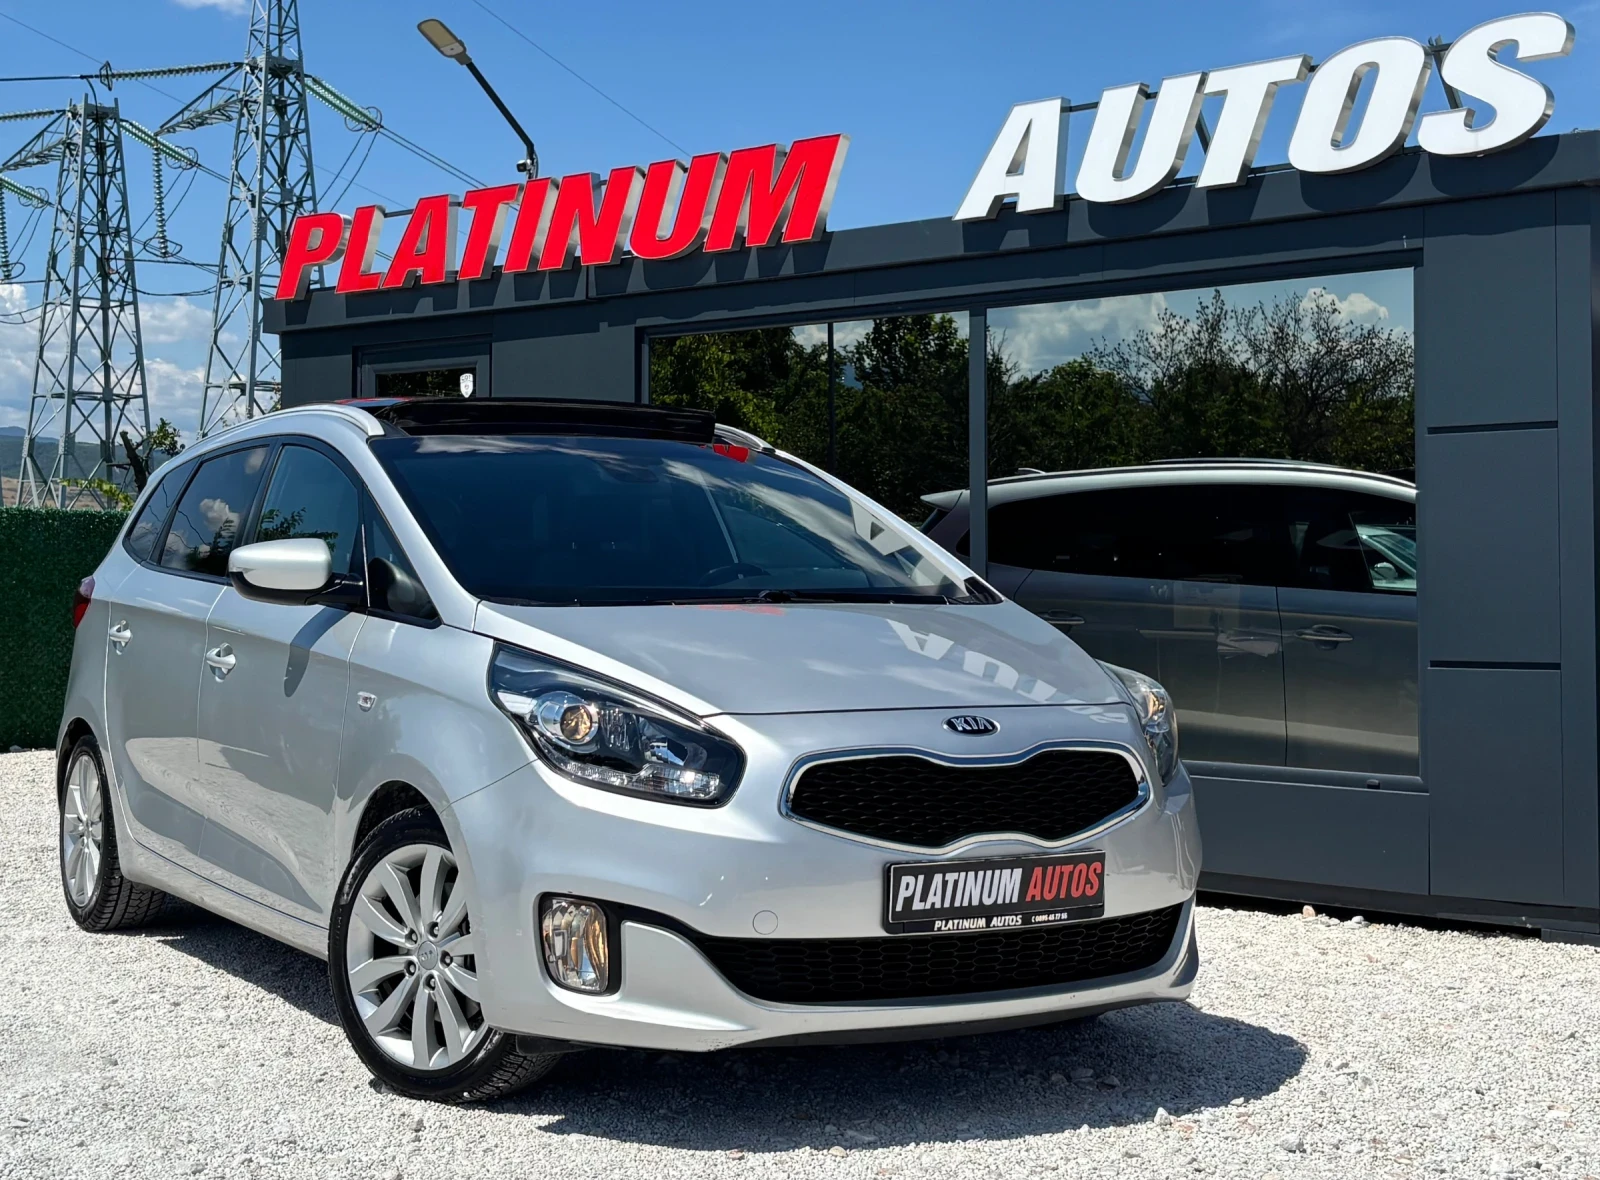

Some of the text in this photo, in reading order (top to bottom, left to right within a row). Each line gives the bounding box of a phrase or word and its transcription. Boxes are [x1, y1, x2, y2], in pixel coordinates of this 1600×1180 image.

[275, 12, 1575, 300] PLATINUM AUTOS
[950, 717, 993, 731] KIA
[895, 862, 1102, 911] PLATINUM AUTOS
[934, 918, 986, 931] PLATINUM
[990, 915, 1022, 927] AUTOS
